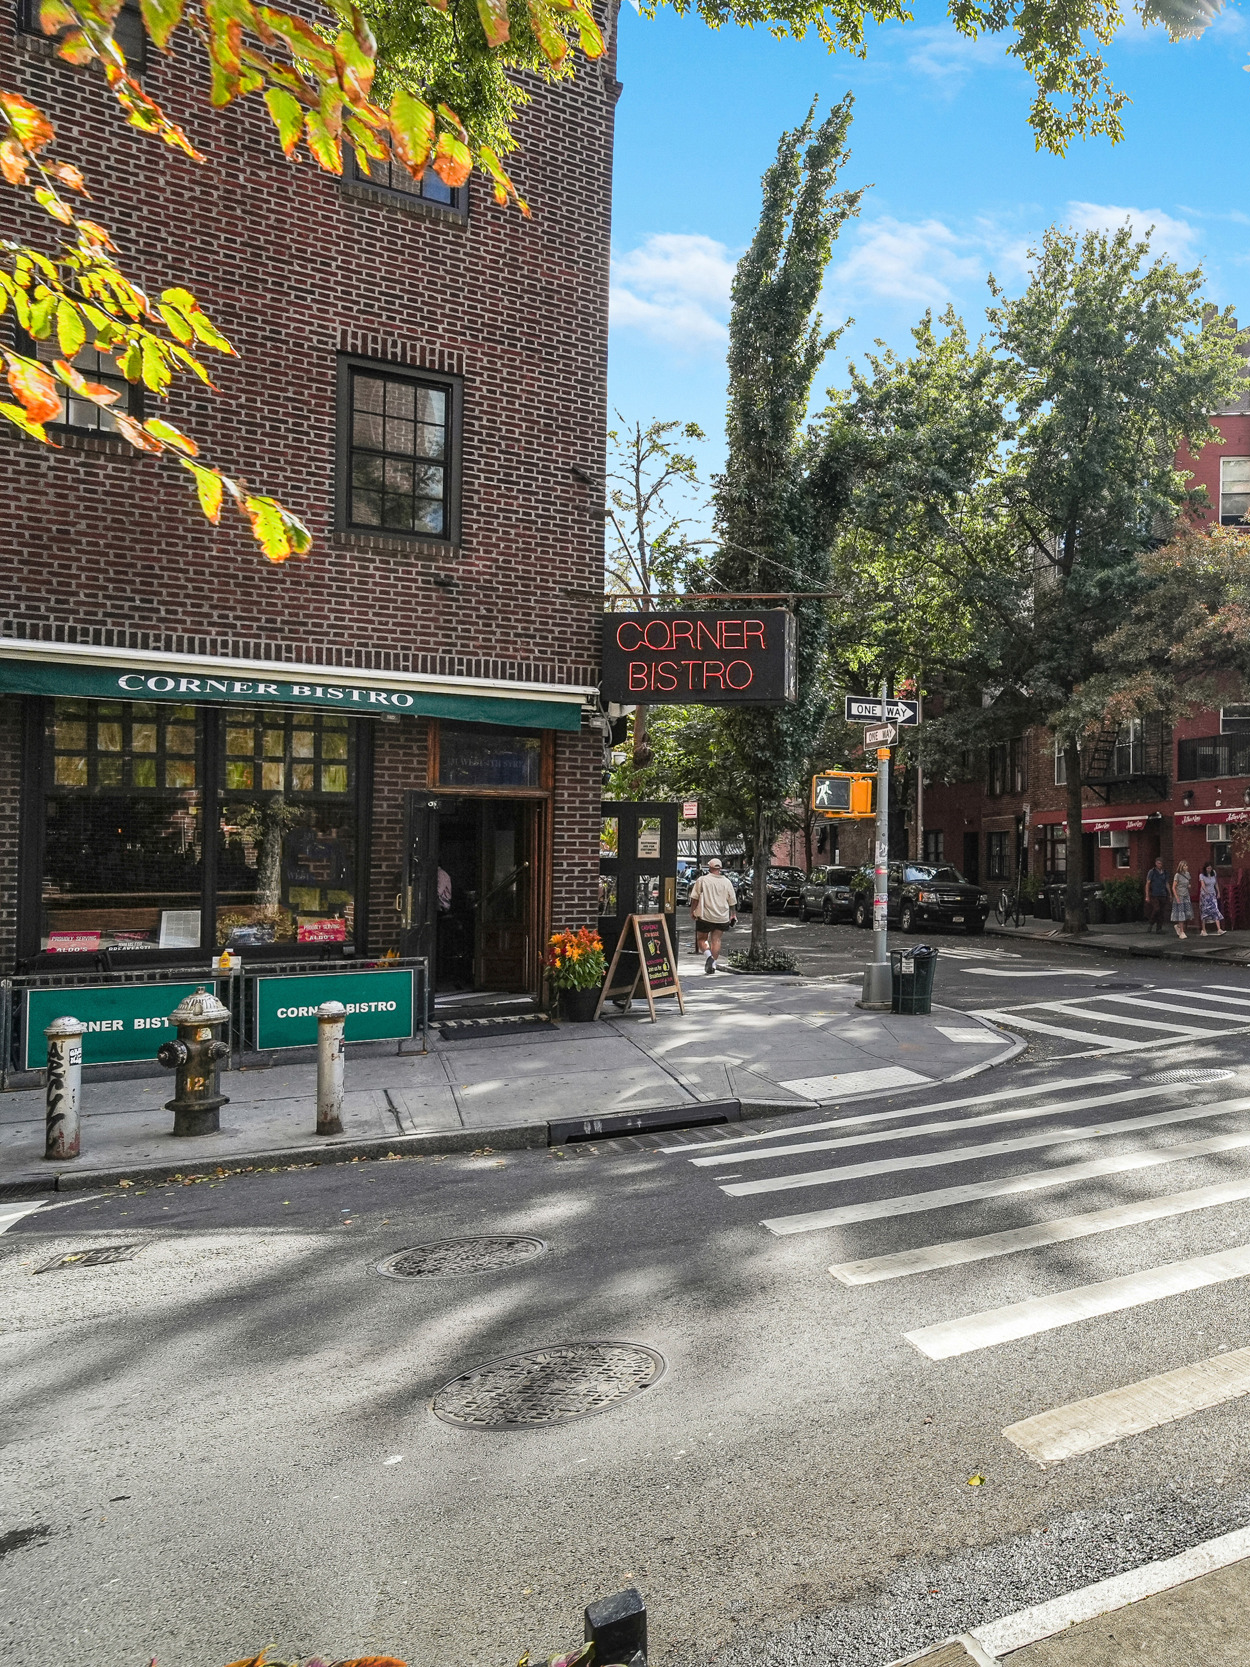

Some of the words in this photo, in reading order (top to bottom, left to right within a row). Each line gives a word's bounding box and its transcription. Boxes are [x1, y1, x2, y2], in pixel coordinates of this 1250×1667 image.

[616, 620, 767, 651] CORNER
[629, 660, 753, 691] BISTRO
[117, 673, 281, 696] CORNER
[290, 684, 415, 708] BISTRO
[856, 704, 878, 716] ONE
[886, 706, 907, 717] WAY
[868, 731, 879, 742] ONE
[882, 728, 893, 739] WAY
[277, 1006, 320, 1018] CORN
[346, 1001, 397, 1014] BISTRO
[82, 1019, 124, 1033] RNER
[134, 1016, 171, 1030] BIST
